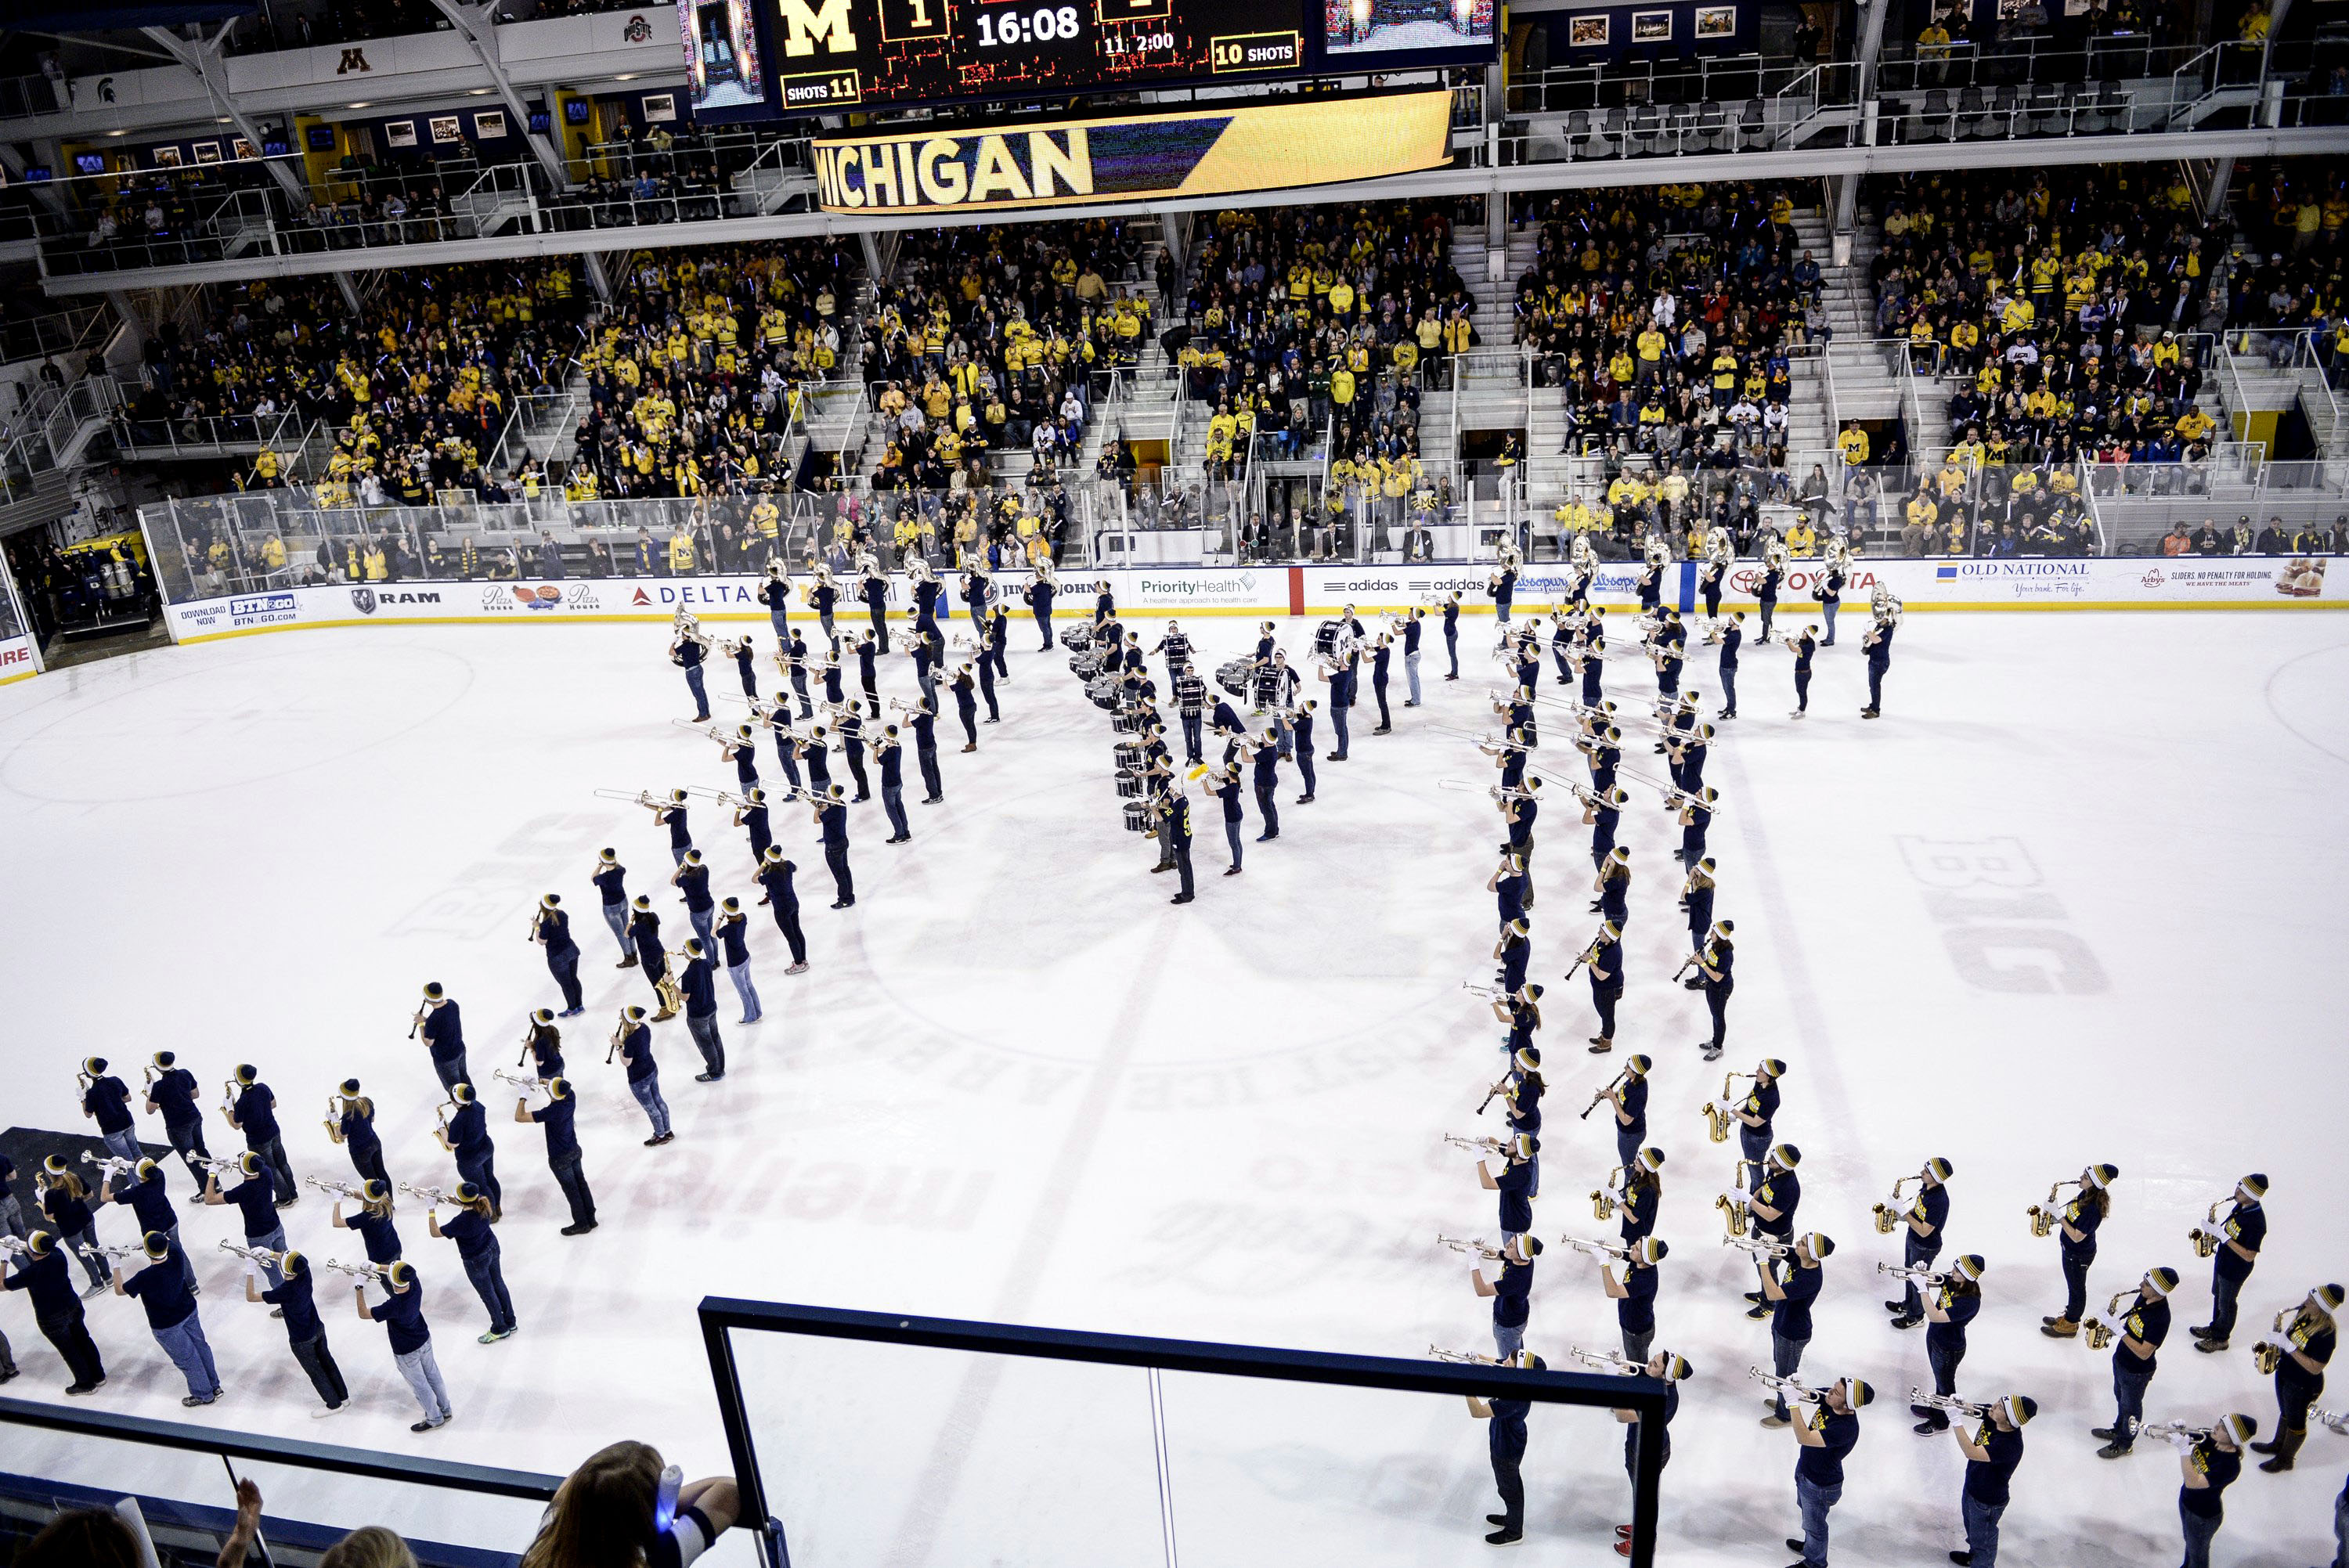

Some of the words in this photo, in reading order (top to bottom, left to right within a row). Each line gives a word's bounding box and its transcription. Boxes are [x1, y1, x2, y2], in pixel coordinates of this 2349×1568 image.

[780, 0, 857, 57] M
[977, 7, 1079, 46] 16:08
[1137, 34, 1173, 51] 2:00
[337, 48, 370, 74] M
[1215, 45, 1242, 65] 10
[1248, 46, 1293, 62] SHOTS
[788, 85, 828, 100] SHOTS
[830, 78, 856, 99] 11
[814, 128, 1093, 207] MICHIGAN
[1848, 443, 1859, 452] M
[1962, 564, 1997, 575] OLD
[2004, 564, 2089, 575] NATIONAL
[2171, 571, 2196, 580] SLIDERS.
[1142, 580, 1240, 594] PriorityHealth
[1348, 579, 1398, 591] adidas
[1434, 579, 1485, 590] adidas
[1776, 572, 1876, 589] OYTA
[660, 586, 752, 604] DELTA
[1059, 583, 1097, 597] JOHN
[2012, 583, 2033, 597] Your
[2035, 583, 2052, 593] bank.
[2055, 583, 2069, 593] For
[379, 593, 441, 604] RAM
[181, 606, 226, 620] DOWNLOAD
[233, 598, 293, 615] BTN2GO
[197, 615, 216, 625] NOW
